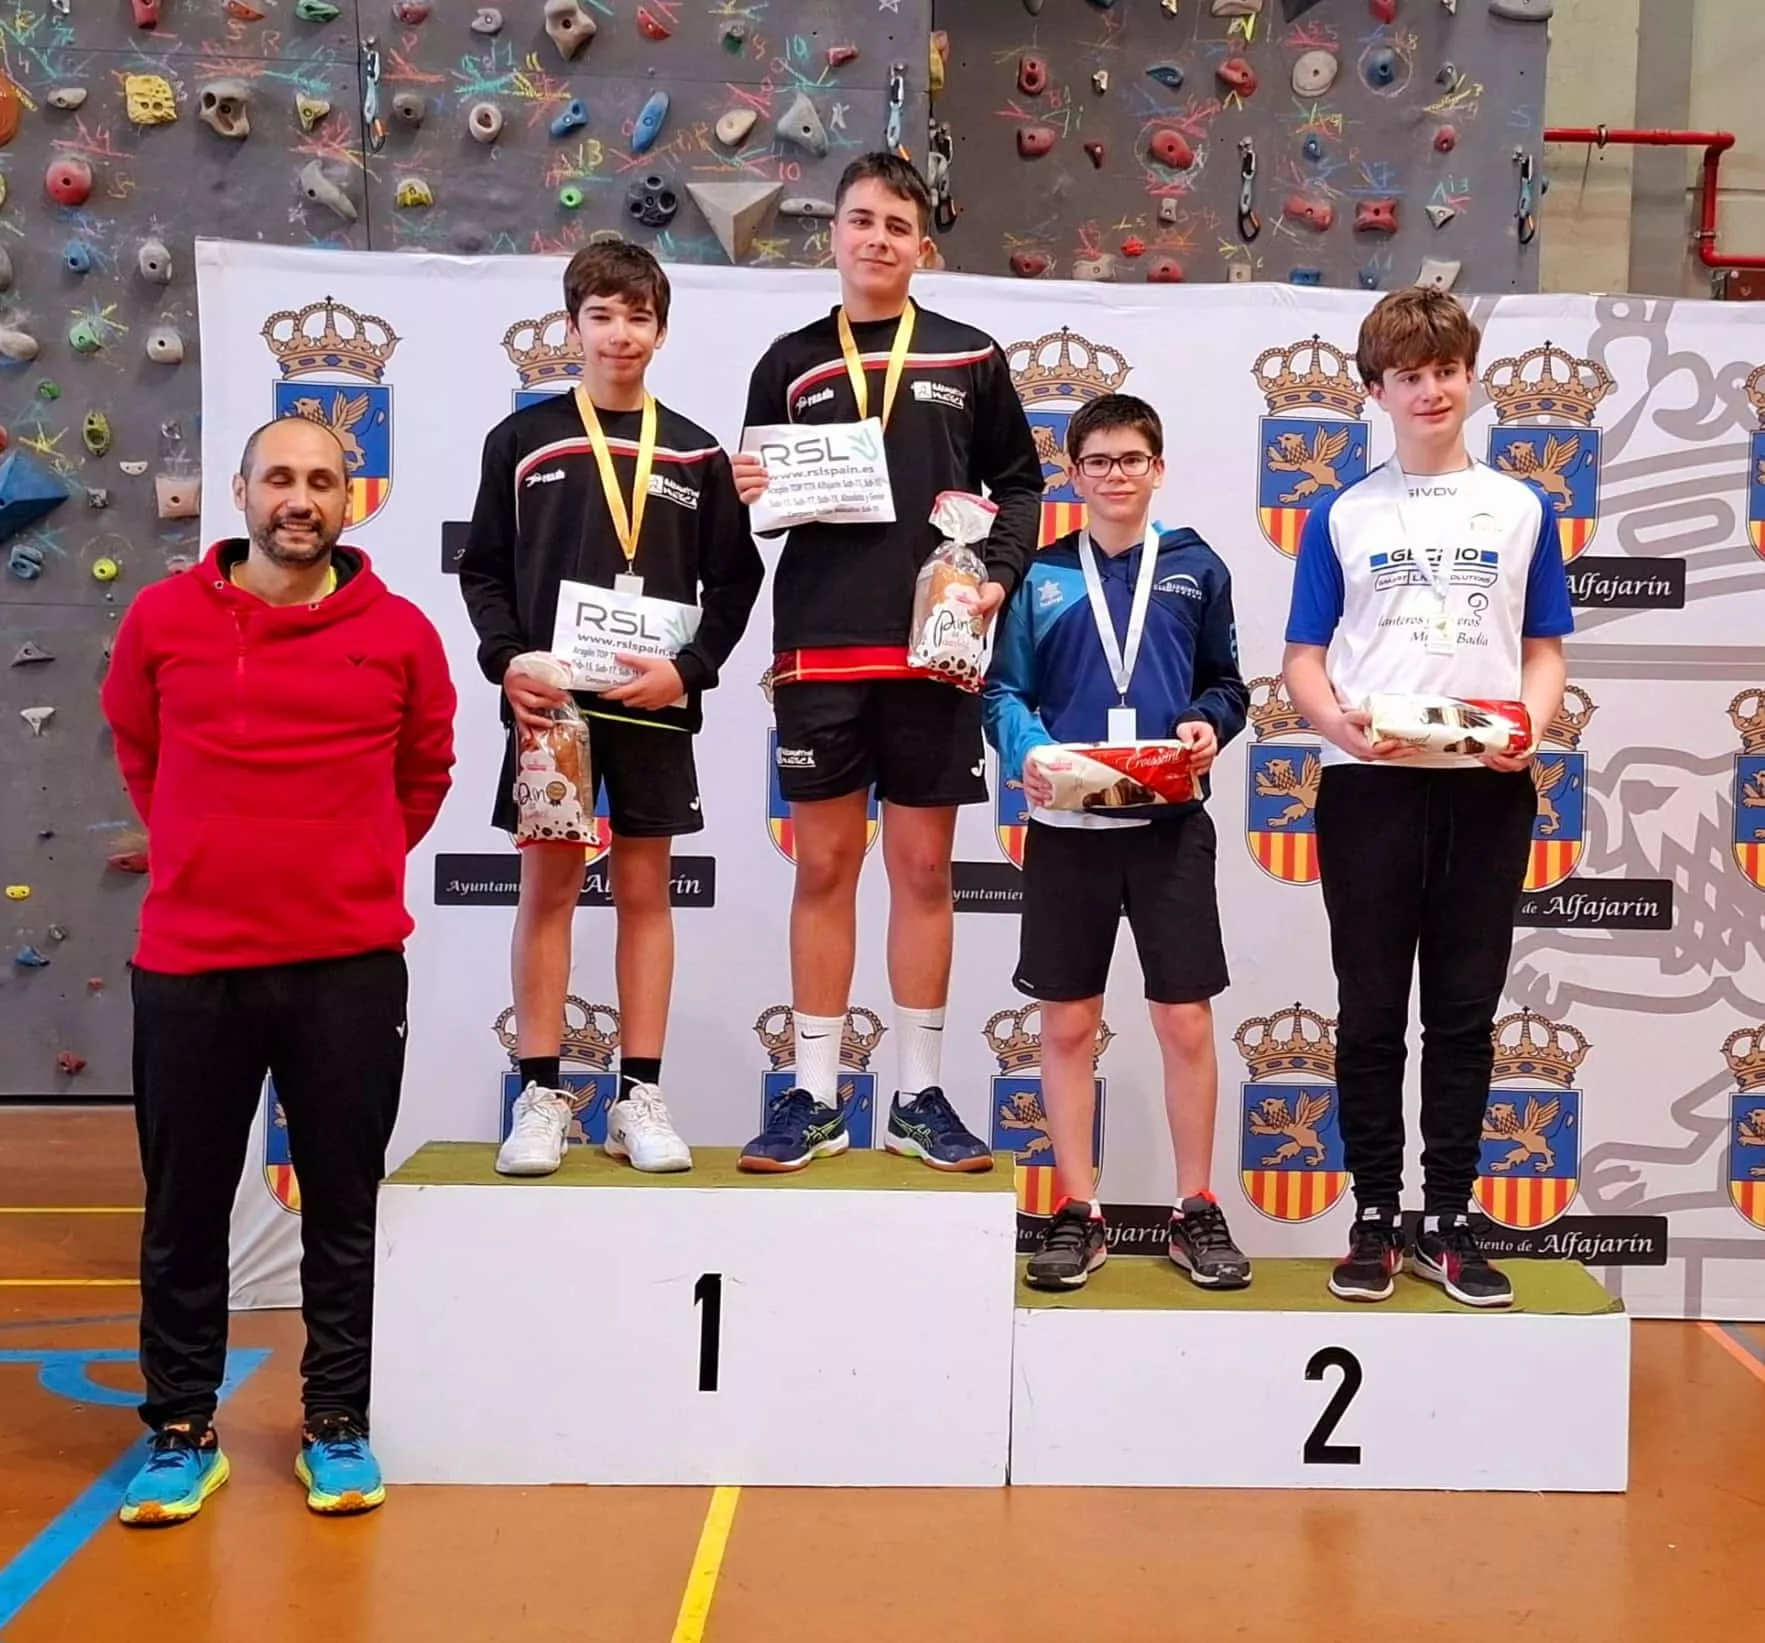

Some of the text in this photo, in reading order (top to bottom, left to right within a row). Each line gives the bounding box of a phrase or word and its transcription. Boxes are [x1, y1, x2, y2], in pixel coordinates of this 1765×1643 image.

[760, 437, 850, 467] RSL
[768, 464, 875, 482] www.rslspain.es
[1565, 572, 1673, 602] Alfajarín
[575, 601, 661, 641] RSL
[576, 632, 677, 658] www.rslspain.e
[445, 879, 522, 897] Ayuntam
[952, 887, 1023, 905] yuntamie
[1521, 893, 1660, 923] de Alfajarín
[1516, 1239, 1533, 1252] de
[1538, 1231, 1654, 1261] Alfajarín
[694, 1272, 724, 1392] 1
[1302, 1346, 1364, 1465] 2
